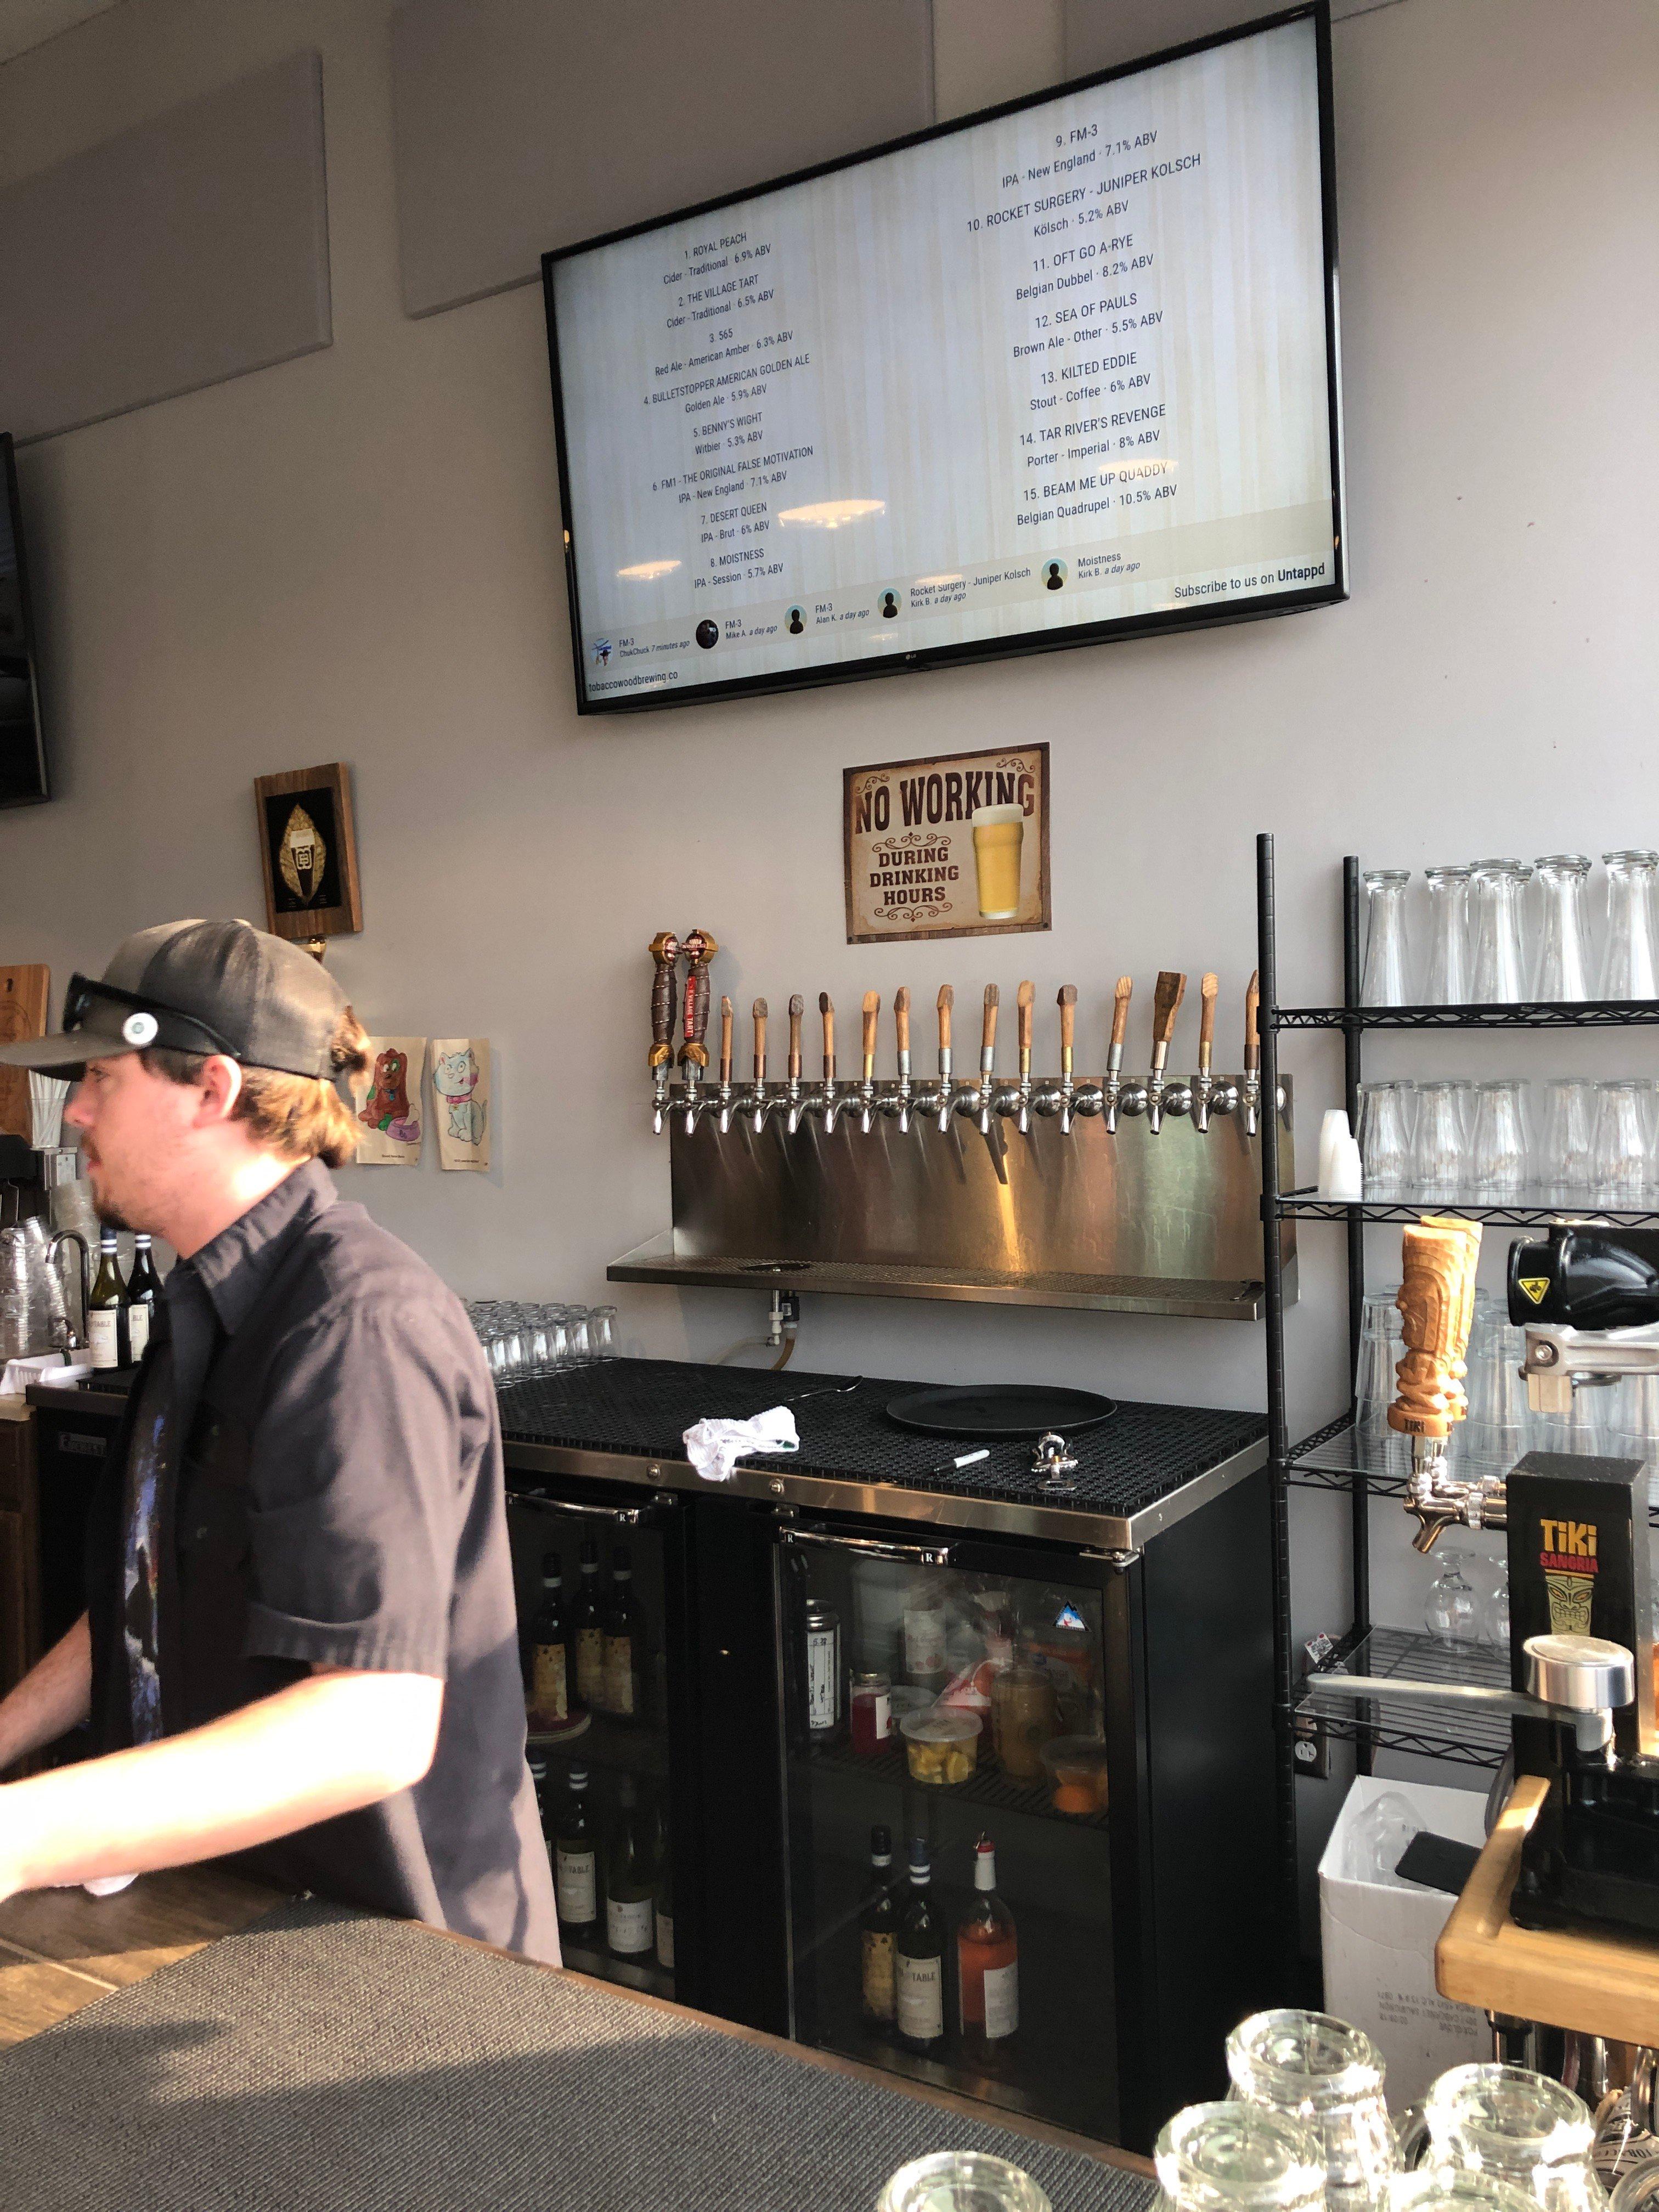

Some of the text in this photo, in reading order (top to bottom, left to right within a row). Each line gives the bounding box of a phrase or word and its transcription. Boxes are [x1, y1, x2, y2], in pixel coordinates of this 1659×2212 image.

[1054, 123, 1098, 148] 9. FM-3
[1002, 129, 1158, 189] IPA New England 7.1% ABV
[967, 152, 1200, 233] 10. ROCKET SURGERY JUNIPER KOLSCH
[1033, 199, 1128, 237] Kölsch 5.2% ABV
[692, 231, 747, 257] ROYAL PEACH
[1032, 233, 1133, 272] 11. OFT GO A-RYE
[663, 271, 682, 285] Cider
[688, 255, 728, 276] Traditional
[754, 242, 771, 257] ABV
[1015, 252, 1154, 301] Belgian Dubbel 8.2% ABV
[686, 273, 759, 303] THE VILLAGE TART
[666, 315, 686, 329] Cider
[691, 300, 731, 321] Traditional
[757, 288, 774, 303] ABV
[1034, 292, 1137, 329] 12. SEA OF PAULS
[718, 327, 733, 341] 565
[1012, 309, 1163, 358] Brown Ale Other 5.5% ABV
[654, 363, 669, 376] Red
[670, 360, 682, 373] Ale
[687, 351, 724, 368] American
[725, 343, 750, 358] Amber
[776, 330, 793, 344] ABV
[1040, 351, 1137, 385] 13. KILTED EDDIE
[652, 352, 810, 404] BULLETSTOPPER AMERICAN GOLDEN ALE
[1029, 372, 1151, 411] Stout Coffee 6% ABV
[684, 399, 711, 413] Golden
[712, 394, 725, 407] Ale
[750, 382, 767, 397] ABV
[701, 411, 763, 436] BENNY'S WIGHT
[1019, 403, 1166, 446] 14. TAR RIVER'S REVENGE
[694, 442, 721, 455] Witbier
[747, 429, 763, 443] ABV
[1026, 428, 1160, 467] Porter Imperial 8% ABV
[661, 444, 813, 489] FM1 THE ORIGINAL FALSE MOTIVATION
[1023, 462, 1167, 501] 15. BEAM ME UP QUADDY
[678, 492, 691, 504] IPA
[696, 489, 713, 500] New
[714, 479, 744, 496] England
[770, 470, 787, 483] ABV
[709, 501, 767, 523] DESERT QUEEN
[1016, 483, 1177, 526] Belgian Quadrupel 10.5% ABV
[700, 532, 714, 543] IPA
[719, 527, 735, 540] Brut
[753, 519, 770, 532] ABV
[718, 547, 764, 566] MOISTNESS
[1077, 552, 1121, 568] Moistness
[693, 577, 707, 589] IPA
[712, 572, 742, 585] Session
[766, 562, 783, 575] ABV
[910, 566, 1031, 597] Rocket Surgery Juniper Kolsch
[1173, 561, 1325, 599] Subscribe to us on Untappd
[724, 618, 742, 629] FM-3
[815, 602, 833, 614] FM-3
[618, 637, 635, 647] FM-3
[855, 771, 1035, 834] NO WORKING
[878, 847, 949, 867] DURING
[870, 865, 959, 888] DRINKING
[883, 886, 946, 906] HOURS
[1540, 1552, 1599, 1573] SANGRIA
